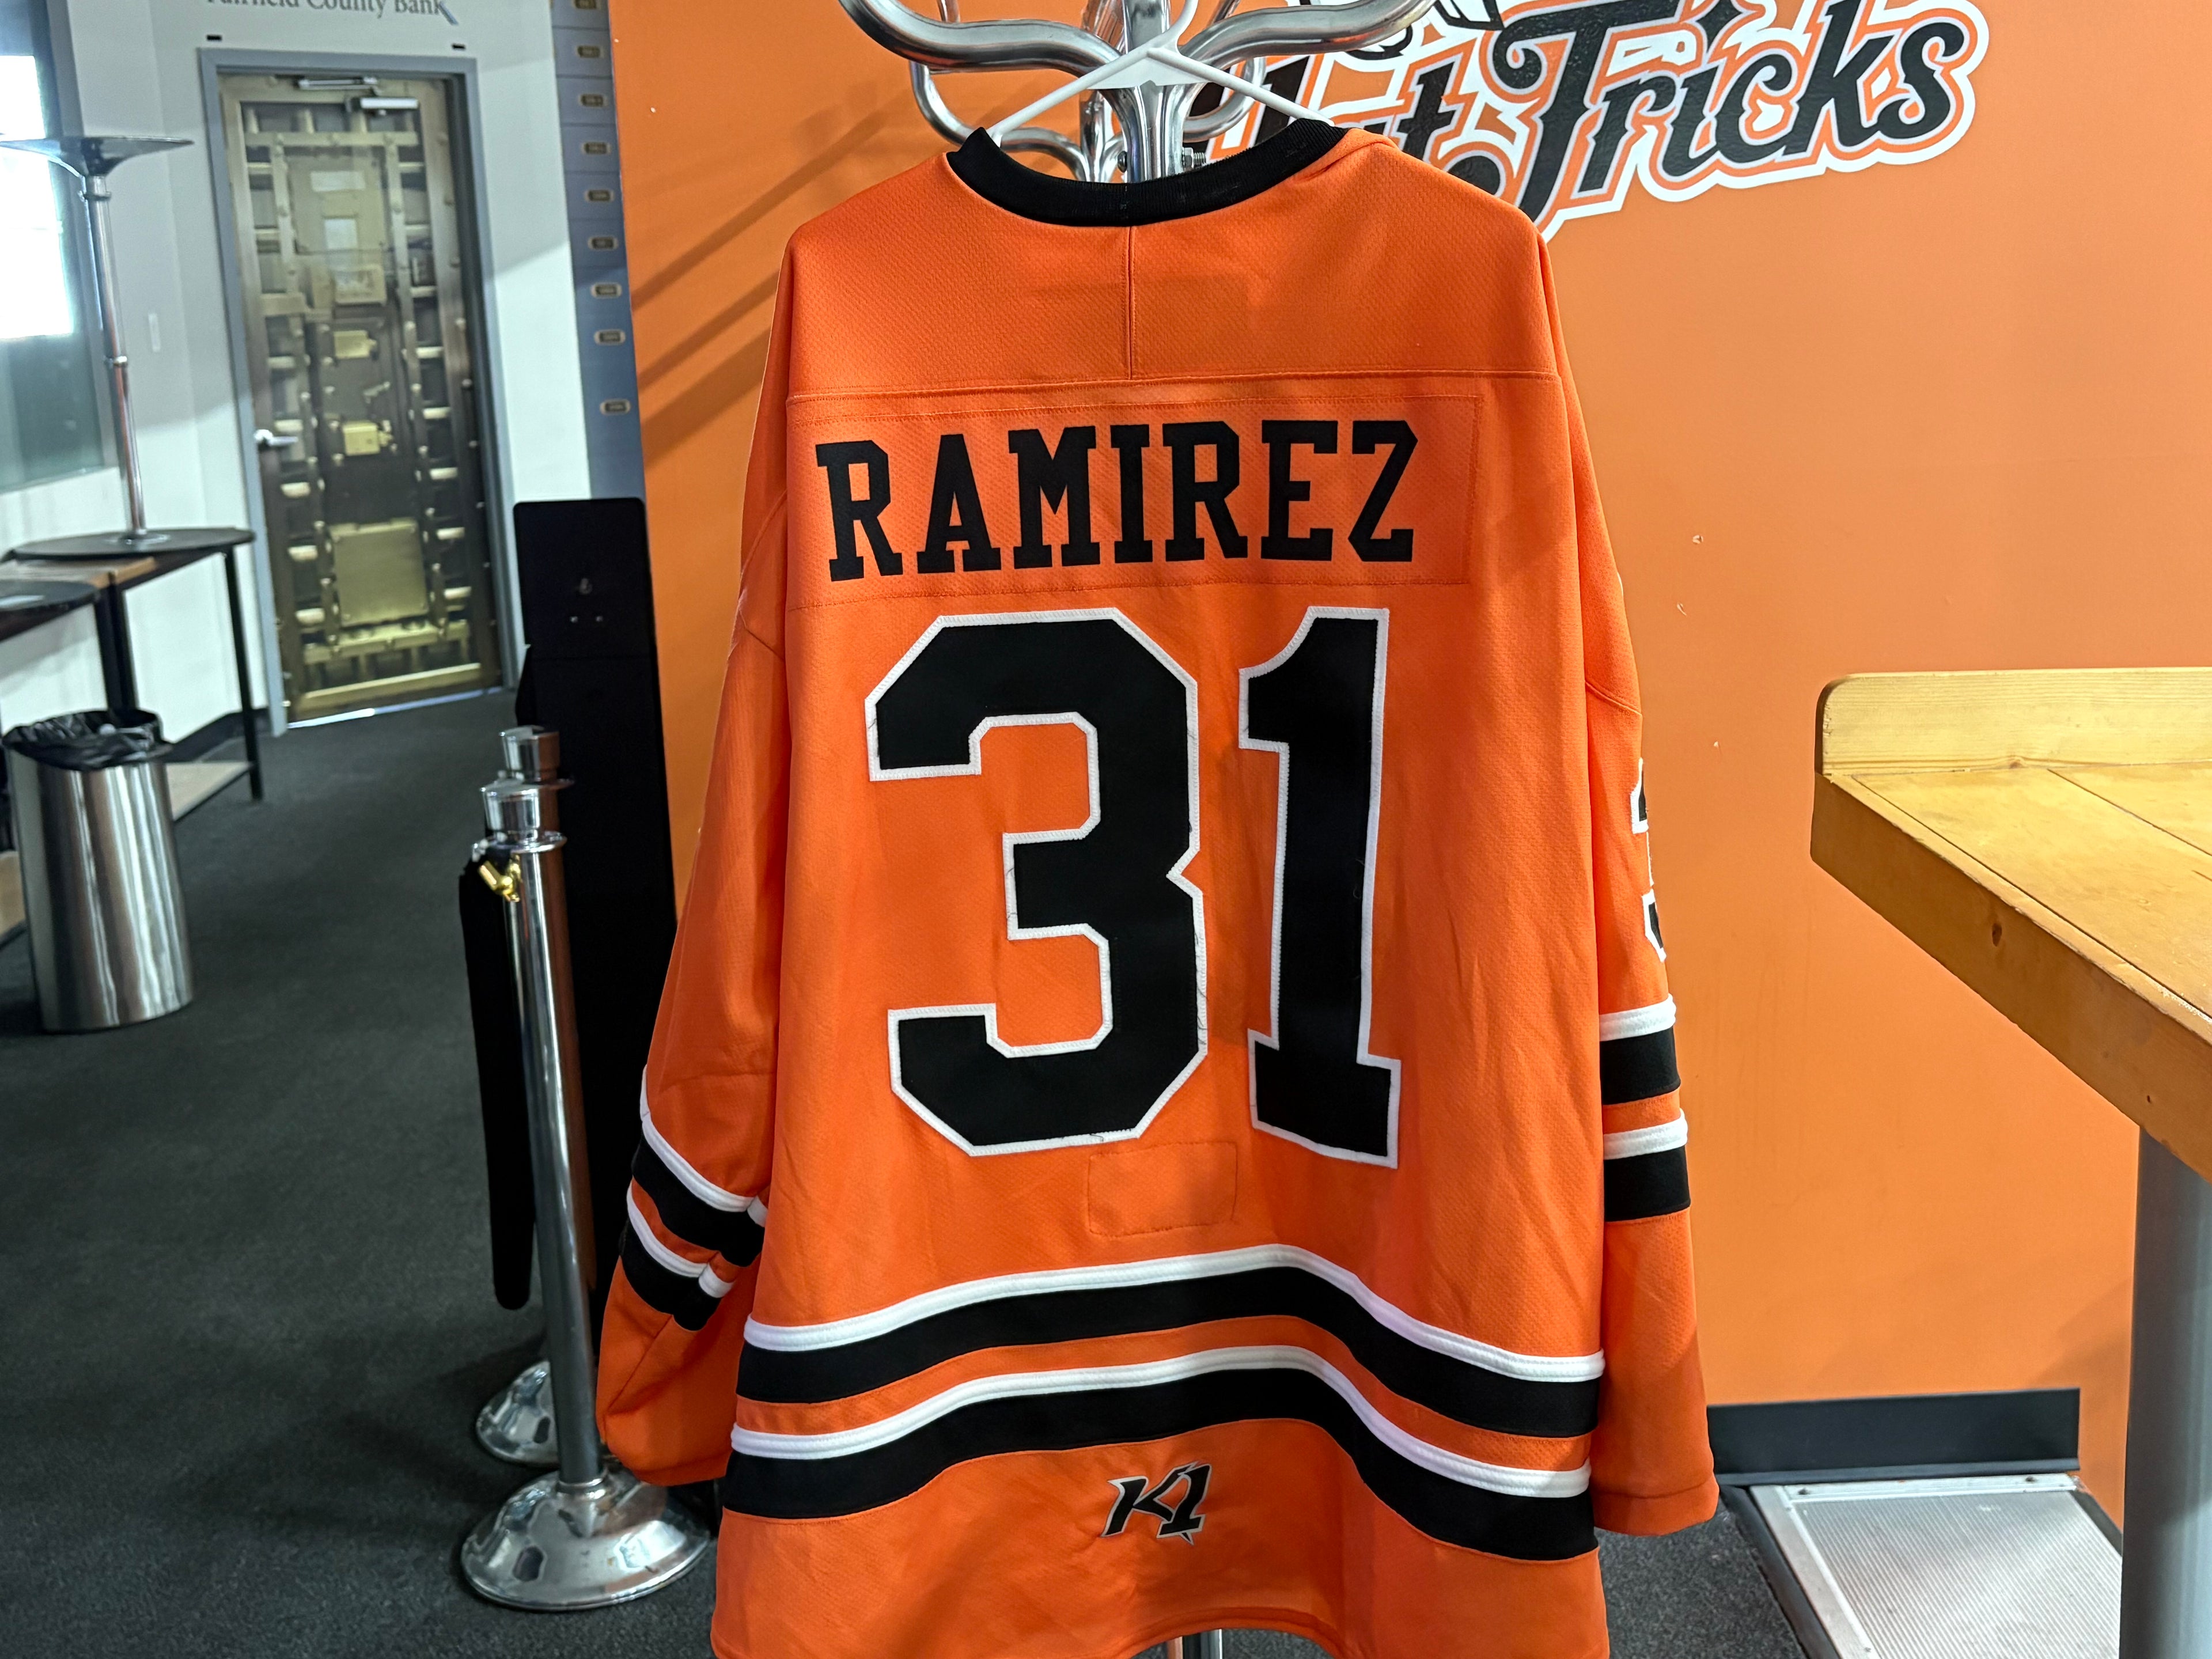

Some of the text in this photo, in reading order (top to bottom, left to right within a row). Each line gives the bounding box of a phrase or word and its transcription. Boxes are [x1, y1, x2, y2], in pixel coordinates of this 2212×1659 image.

[395, 0, 458, 25] Bank
[1489, 0, 1969, 226] Tricks
[816, 420, 1418, 582] RAMIREZ
[864, 605, 1401, 1169] 31
